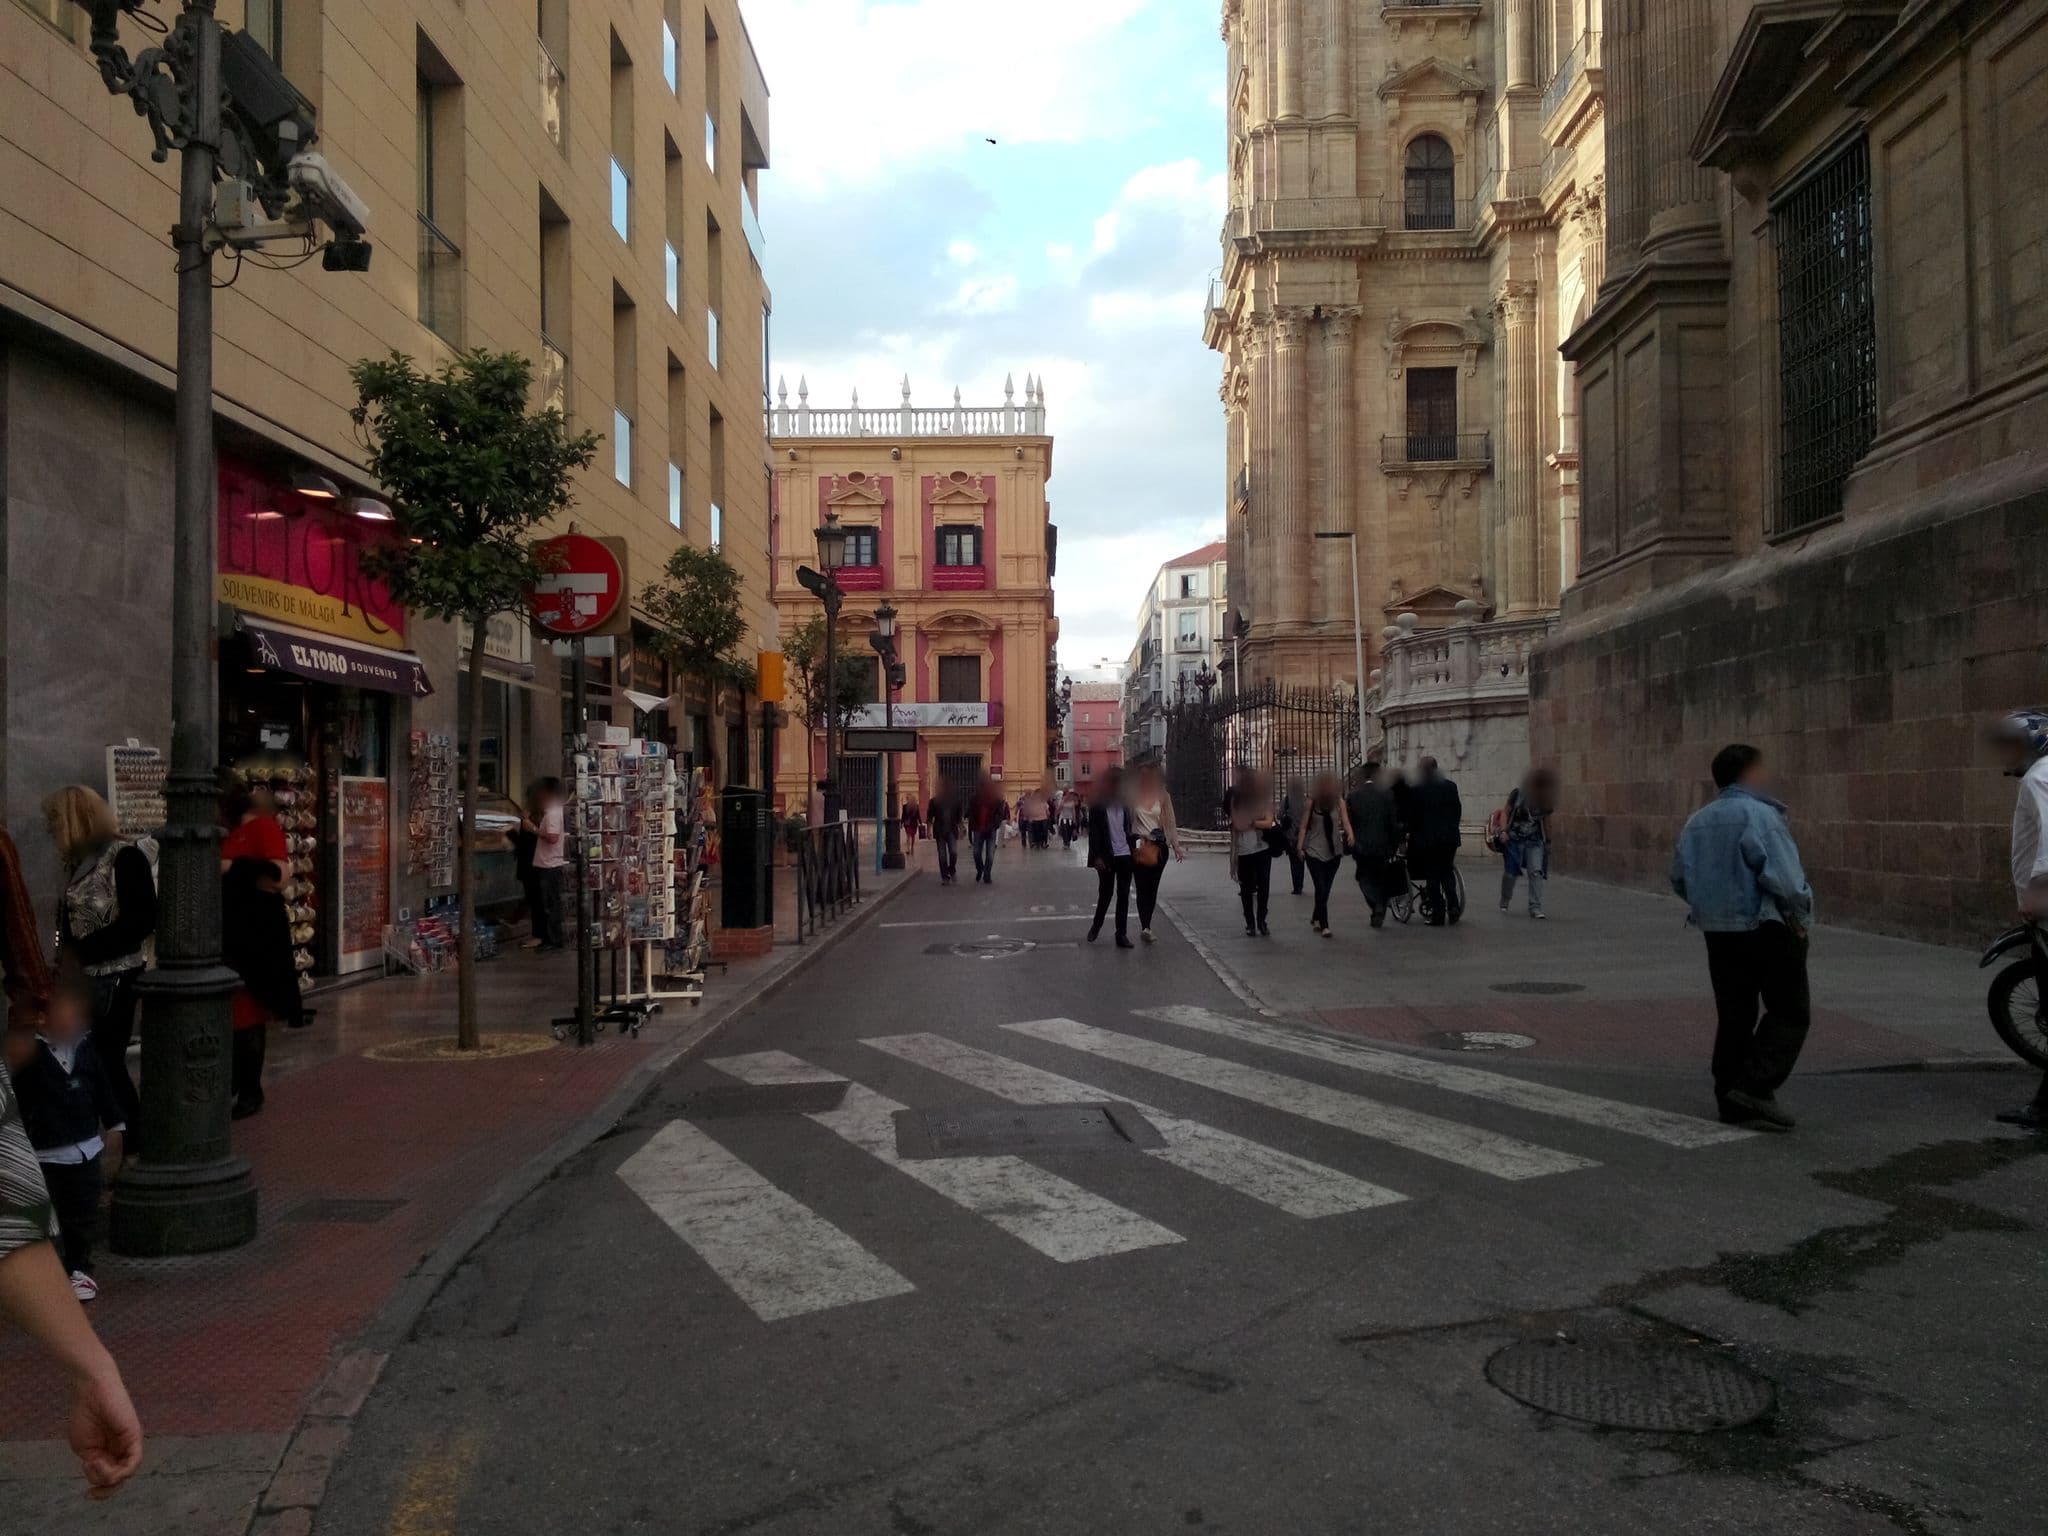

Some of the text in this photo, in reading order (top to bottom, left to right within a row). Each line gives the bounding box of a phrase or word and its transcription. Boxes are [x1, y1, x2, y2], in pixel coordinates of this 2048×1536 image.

[223, 579, 280, 608] SOUVENIRS
[284, 594, 296, 614] DE
[291, 644, 397, 679] EL TORO SOUVENIRS
